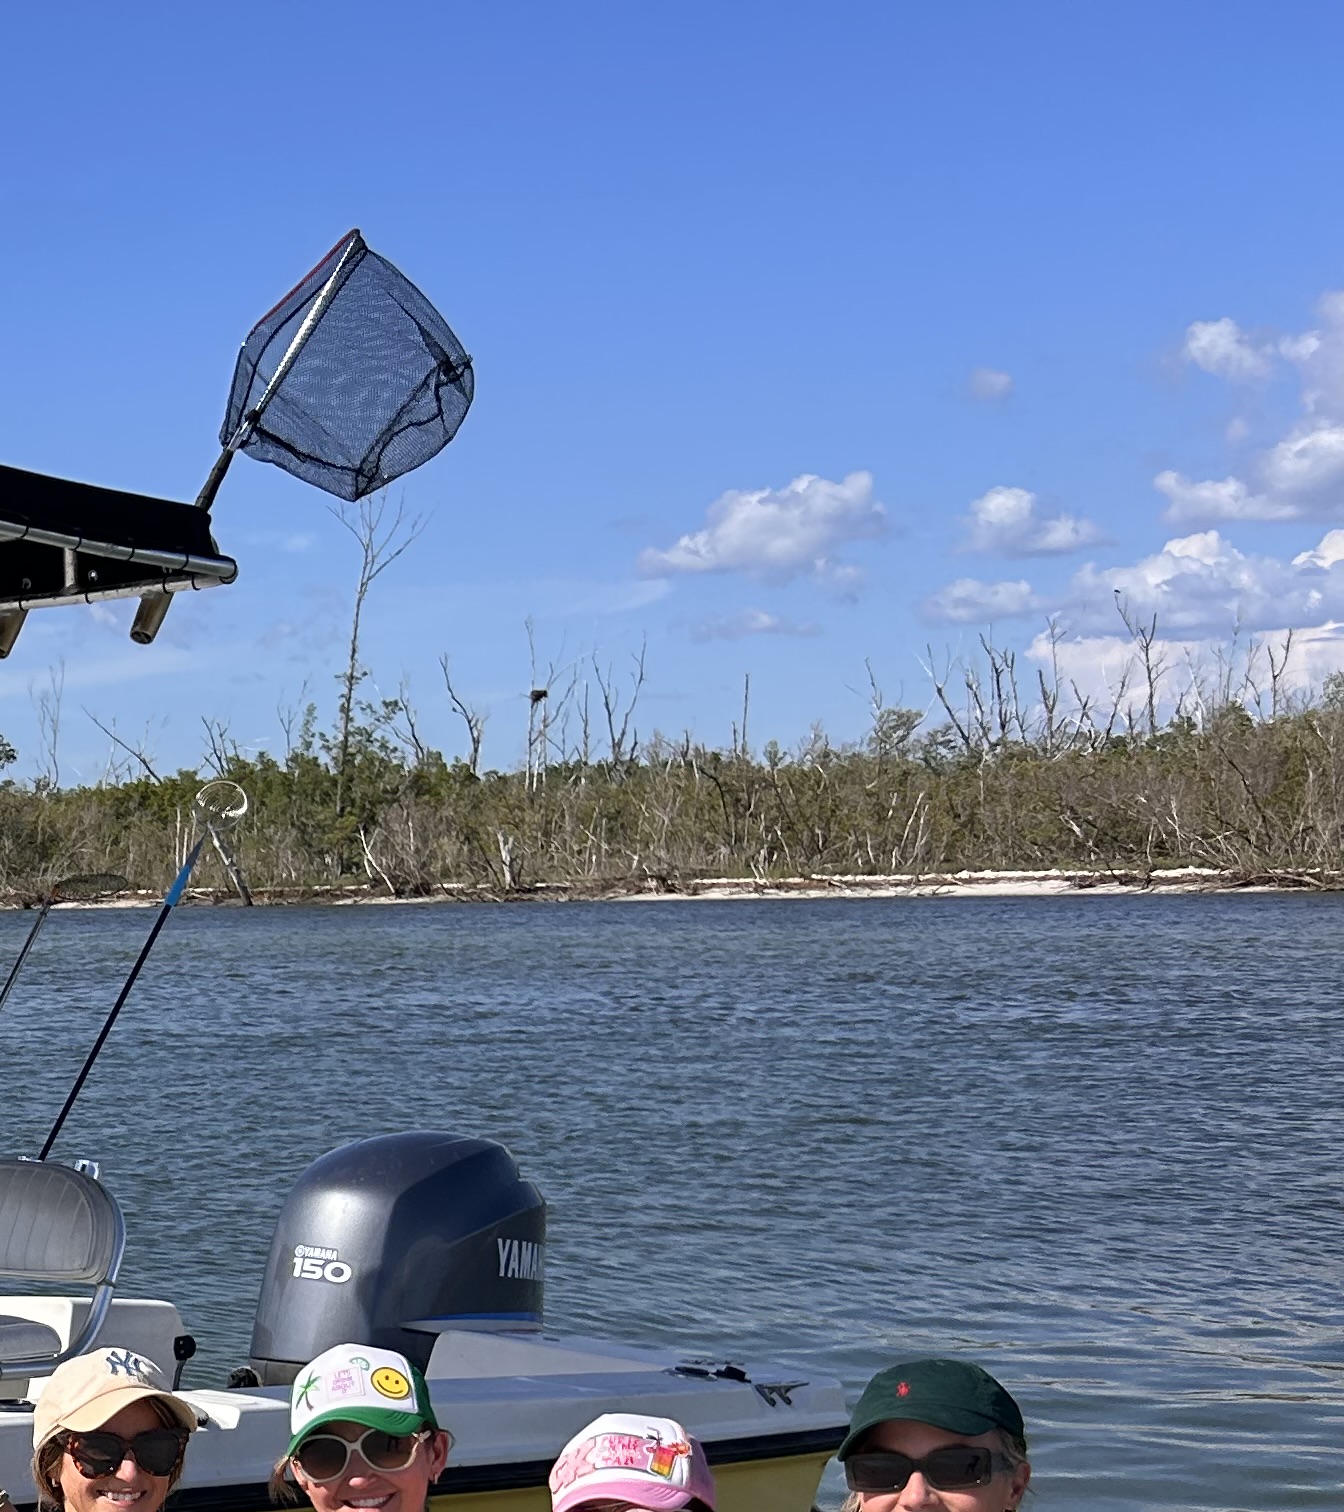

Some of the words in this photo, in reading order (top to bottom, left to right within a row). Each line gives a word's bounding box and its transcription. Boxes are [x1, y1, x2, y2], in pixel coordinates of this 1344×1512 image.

[303, 1245, 338, 1261] YAMAHA
[497, 1238, 543, 1281] YAMA
[292, 1257, 352, 1284] 150
